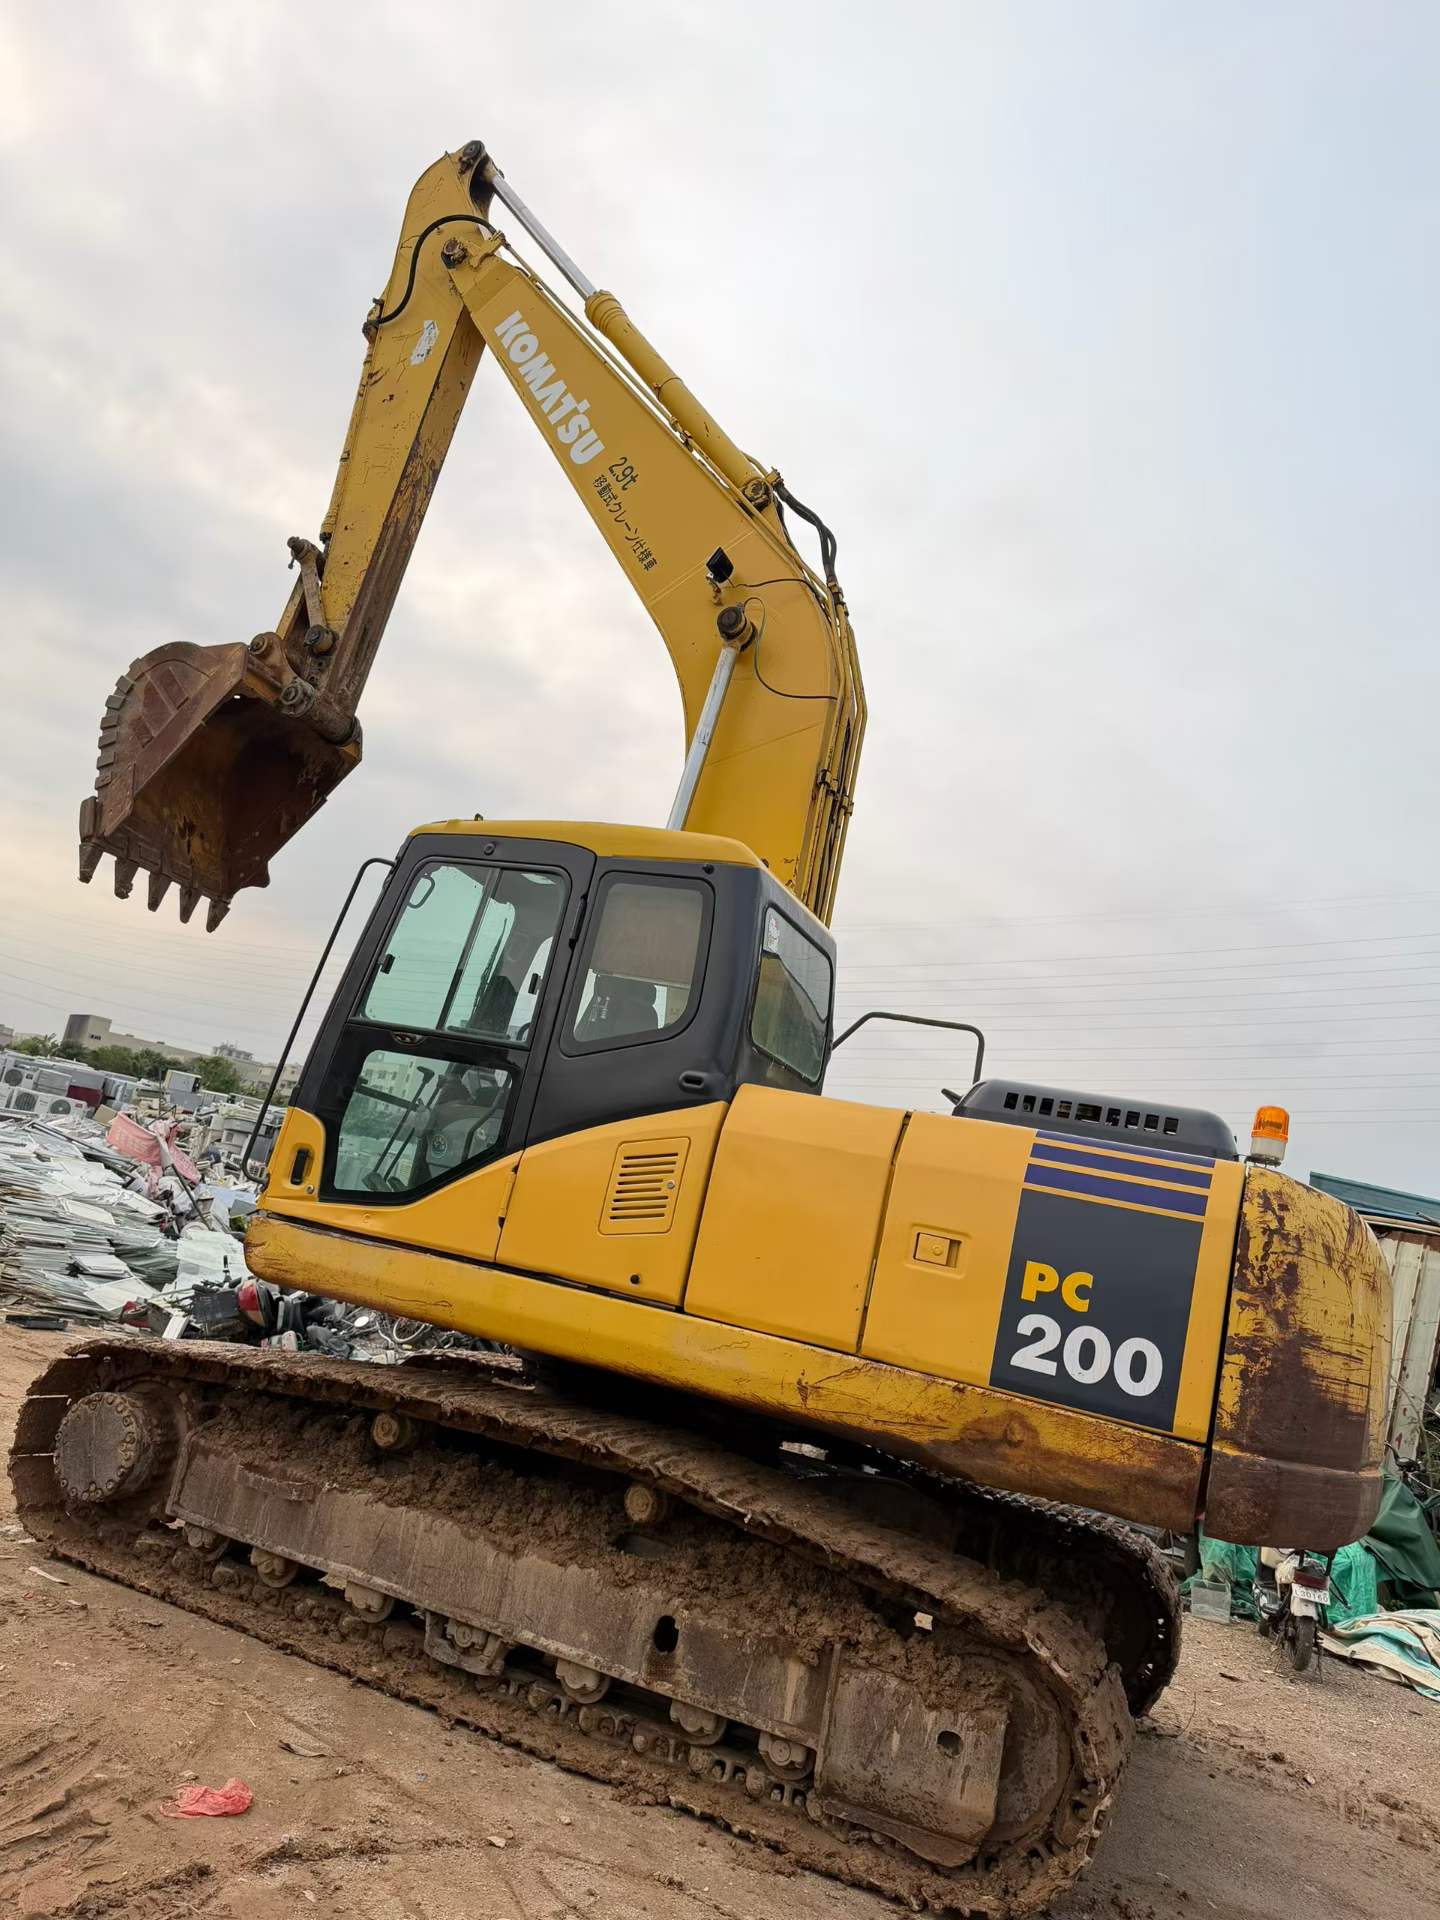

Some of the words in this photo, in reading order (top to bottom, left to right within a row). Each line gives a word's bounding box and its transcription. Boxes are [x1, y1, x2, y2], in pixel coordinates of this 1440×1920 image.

[494, 311, 605, 464] KOMATSU
[592, 474, 658, 571] 移動式クレーン仕様車
[1021, 1260, 1094, 1313] PC
[1010, 1314, 1163, 1396] 200
